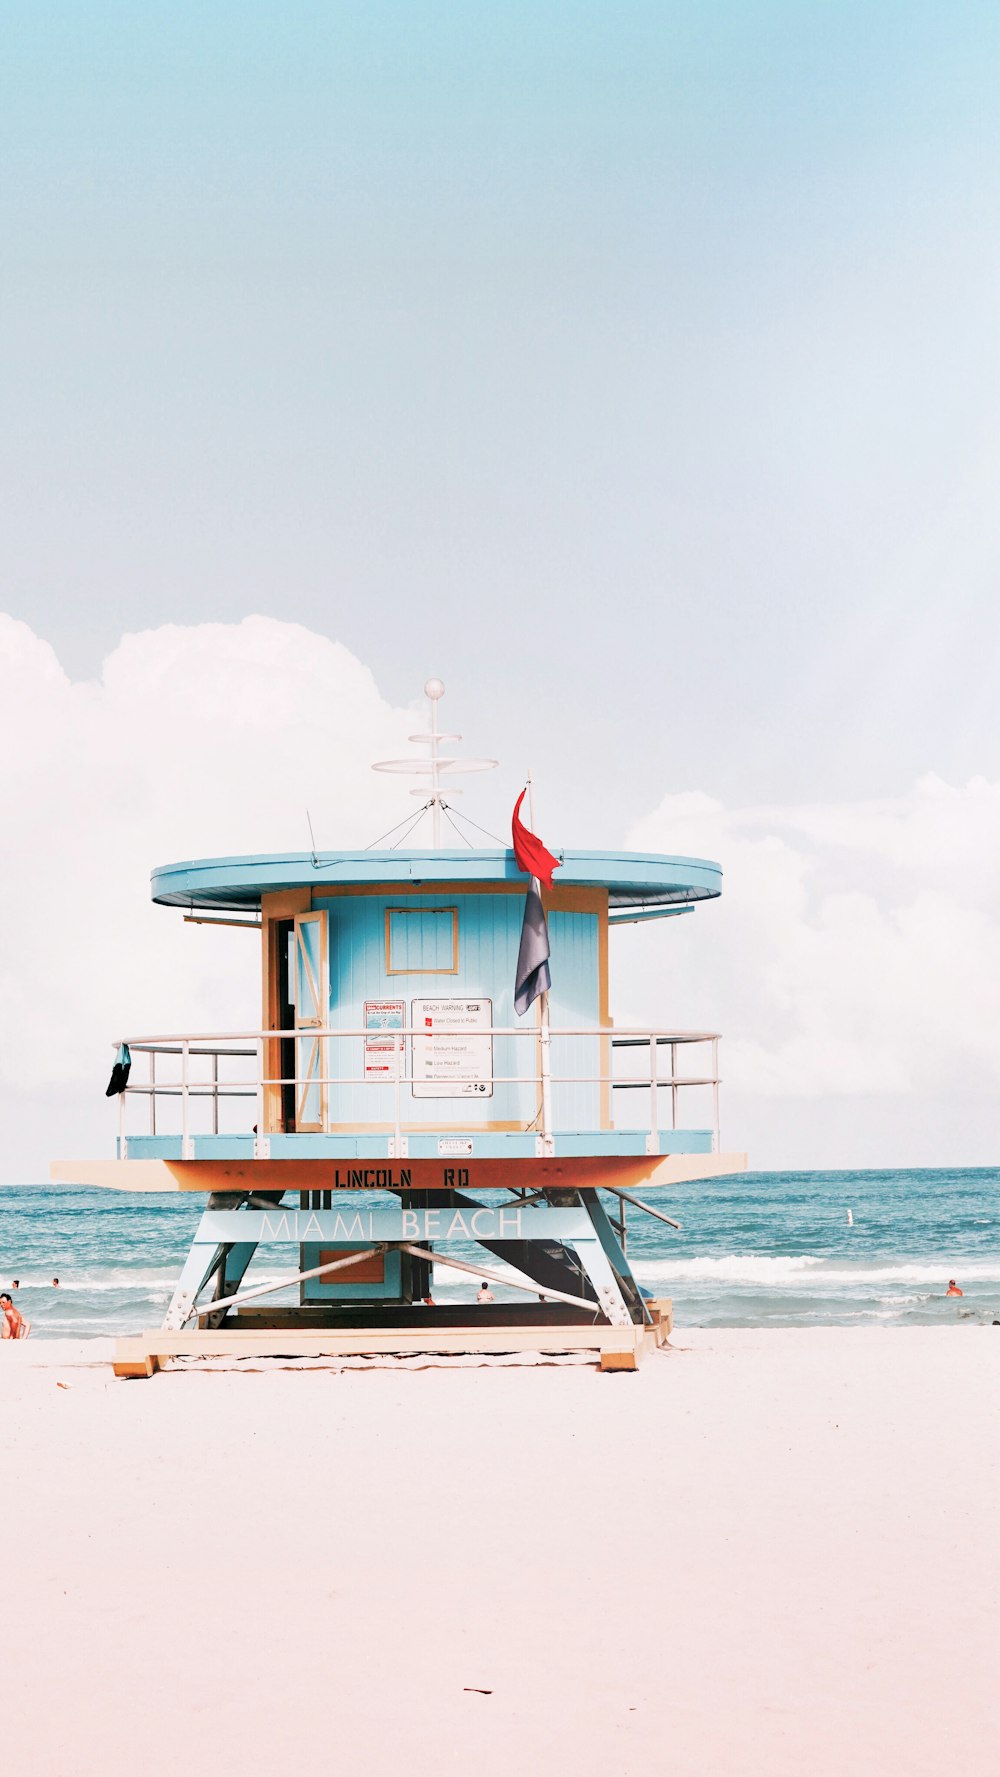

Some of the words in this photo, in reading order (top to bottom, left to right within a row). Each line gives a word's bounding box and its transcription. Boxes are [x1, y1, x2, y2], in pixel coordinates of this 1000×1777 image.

[423, 1004, 439, 1012] BEACH
[441, 1004, 464, 1012] WARNING
[335, 1169, 412, 1188] LINCOLN
[443, 1168, 469, 1187] RD
[258, 1212, 373, 1241] MIAMI
[402, 1208, 522, 1240] BEACH
